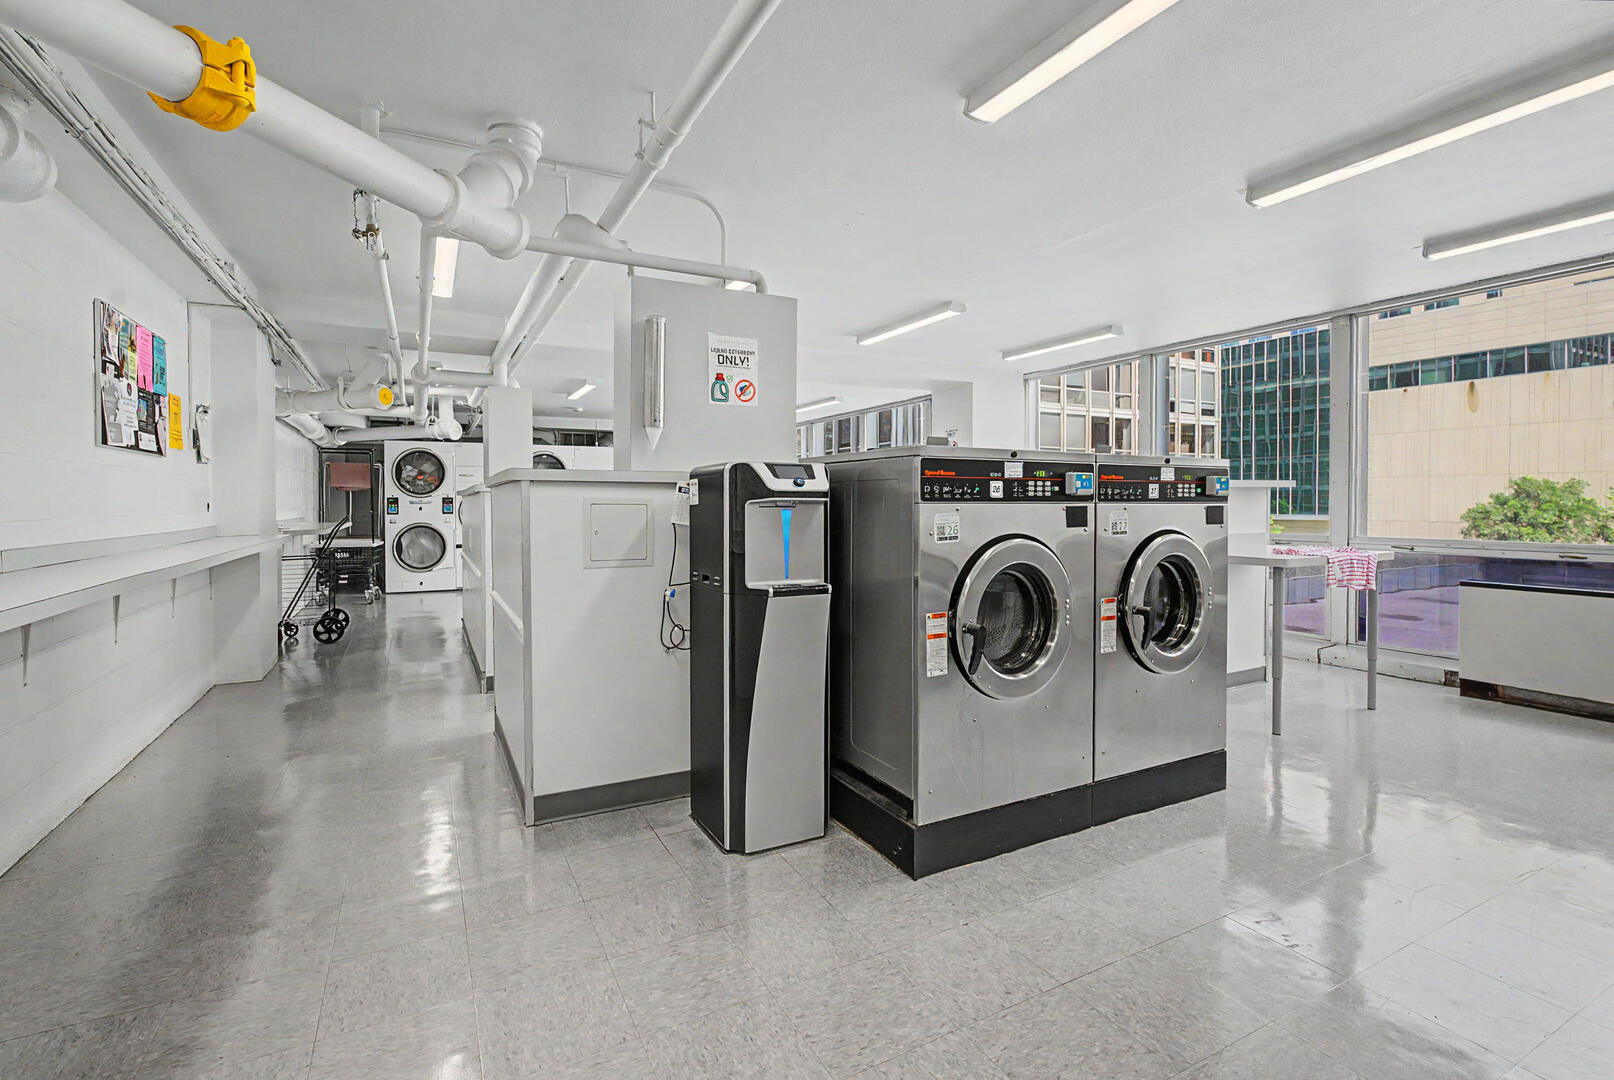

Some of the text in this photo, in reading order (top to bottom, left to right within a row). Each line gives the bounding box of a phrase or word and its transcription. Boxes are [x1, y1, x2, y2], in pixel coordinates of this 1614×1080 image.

[717, 354, 749, 367] ONLY!
[992, 485, 1001, 494] 26
[947, 524, 959, 536] 26
